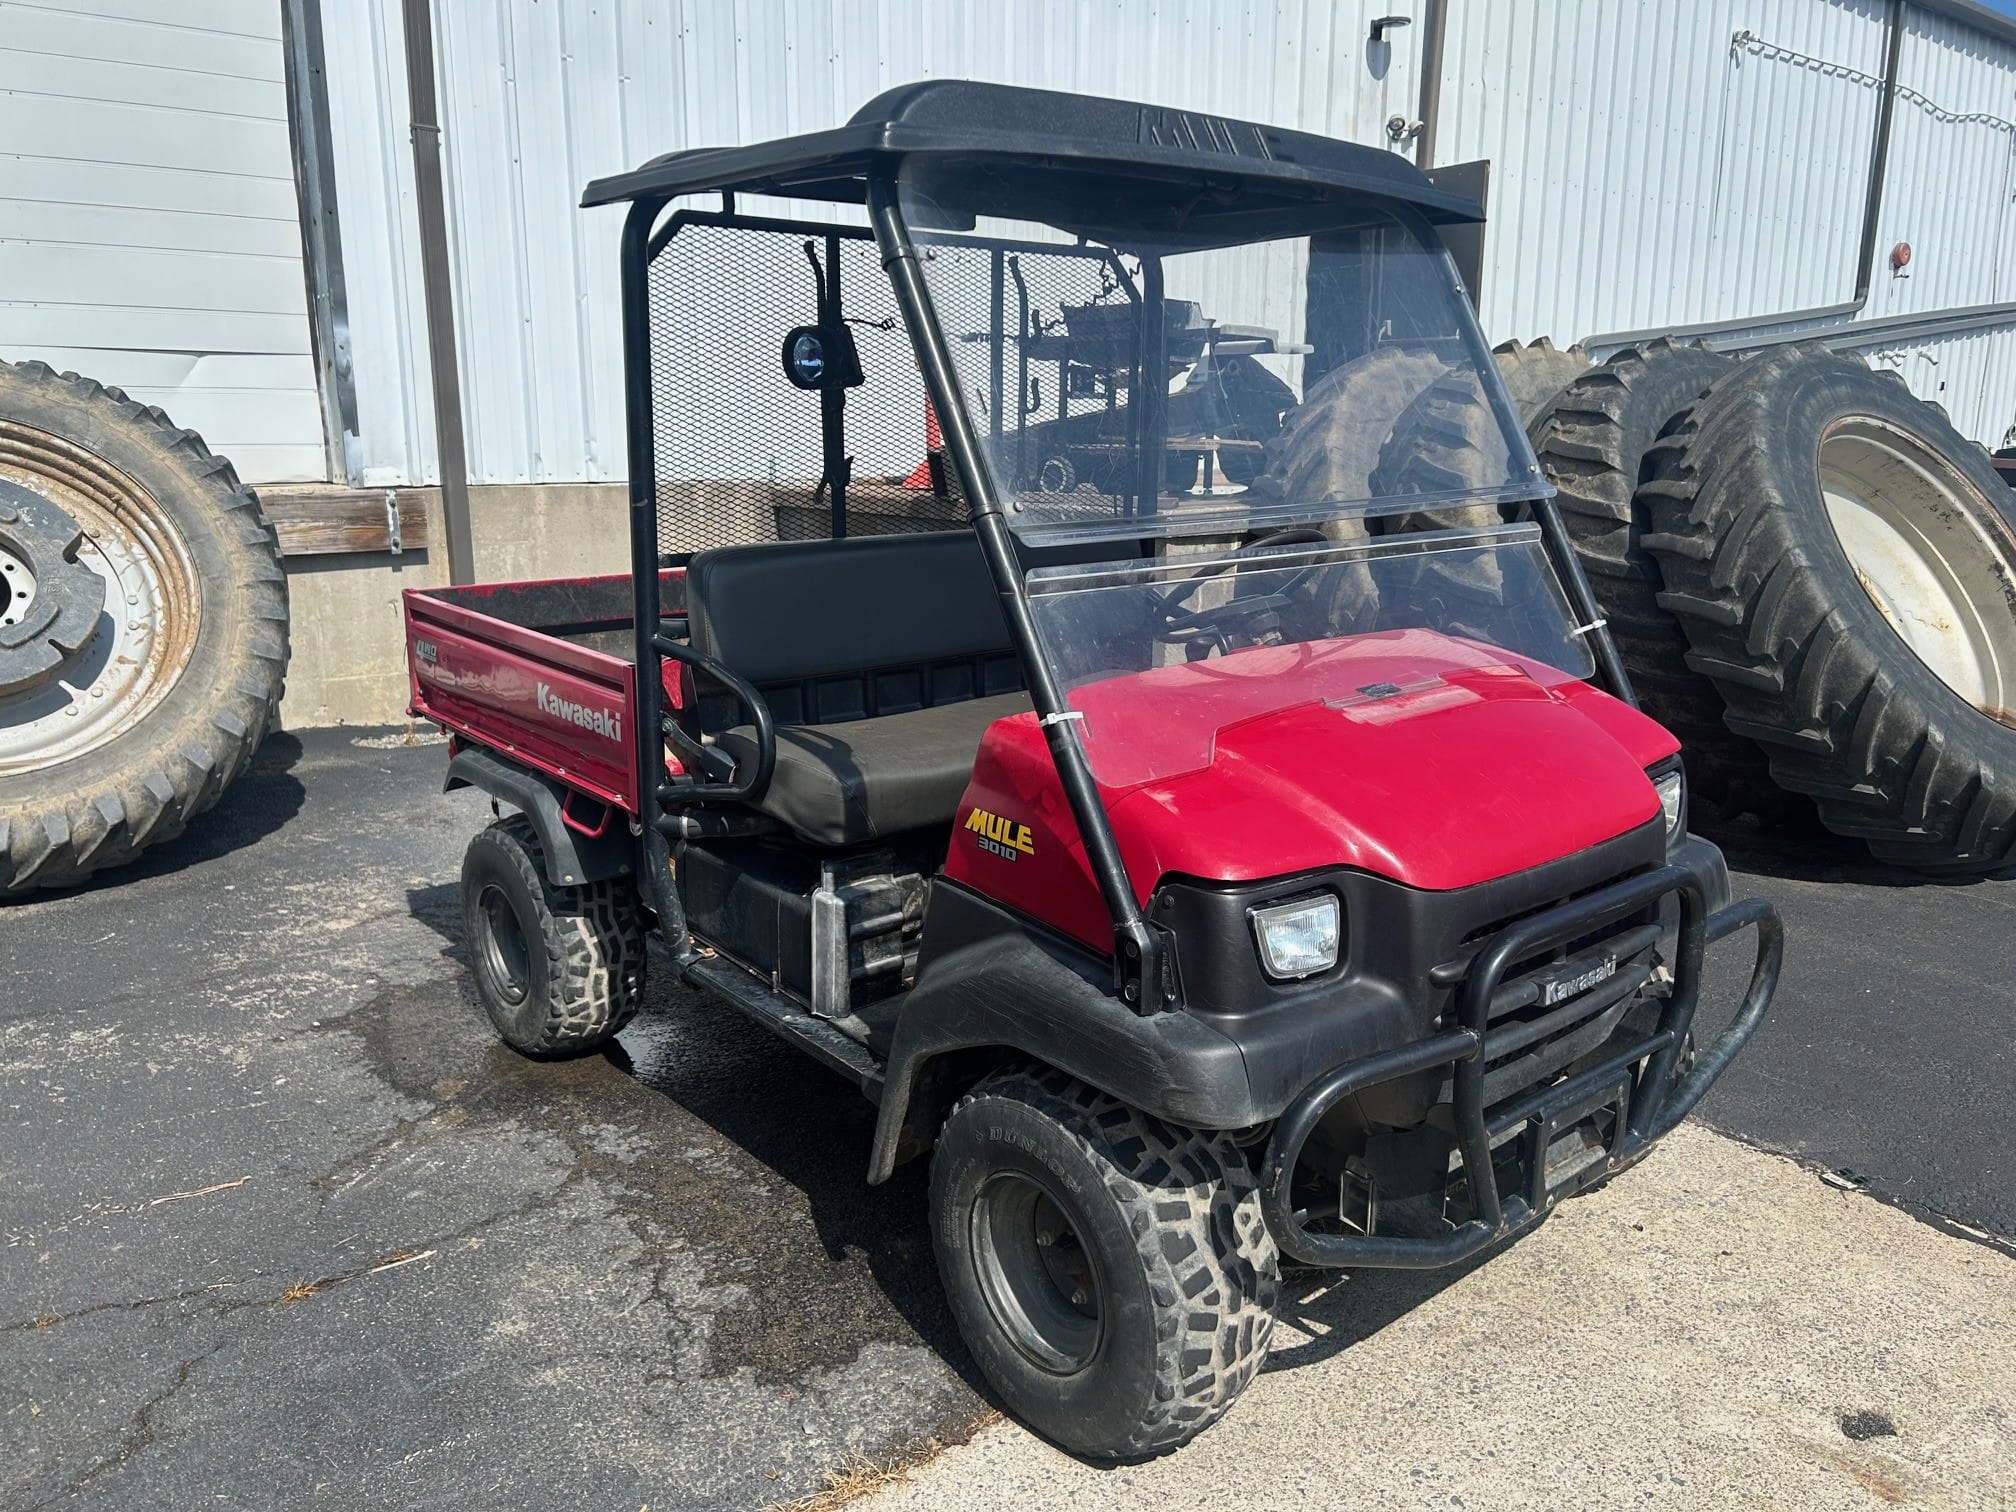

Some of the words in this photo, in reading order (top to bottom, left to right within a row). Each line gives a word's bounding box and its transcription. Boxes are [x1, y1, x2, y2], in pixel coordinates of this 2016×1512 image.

[536, 681, 622, 743] Kawasaki
[964, 807, 1035, 856] MULE
[978, 836, 1017, 862] 3010
[1545, 954, 1617, 1006] Kawasaki
